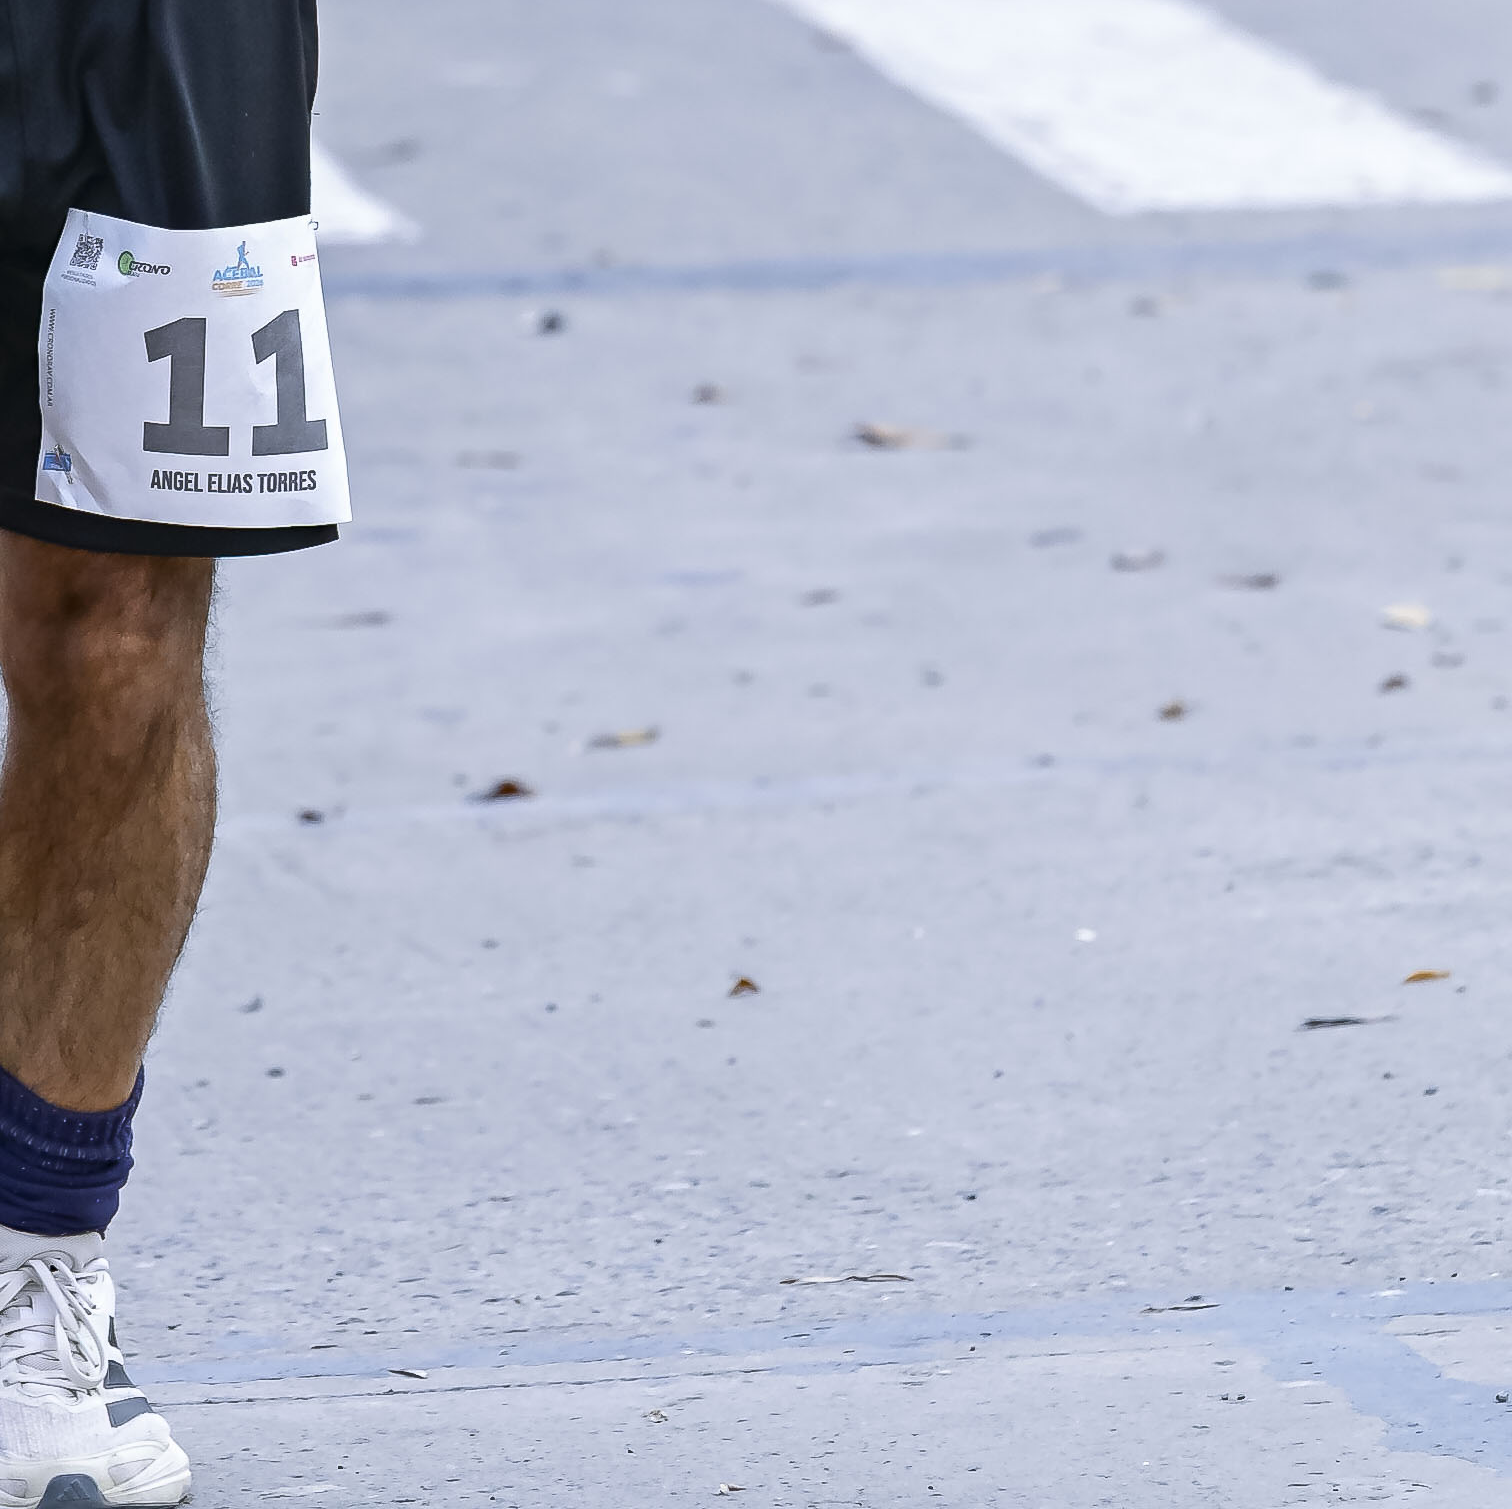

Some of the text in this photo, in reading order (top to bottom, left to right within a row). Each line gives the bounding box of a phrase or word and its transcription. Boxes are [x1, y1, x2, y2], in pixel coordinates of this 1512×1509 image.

[212, 266, 264, 282] ACEBAL
[143, 308, 329, 457] 11
[150, 469, 317, 494] ANGEL ELIAS TORRES
